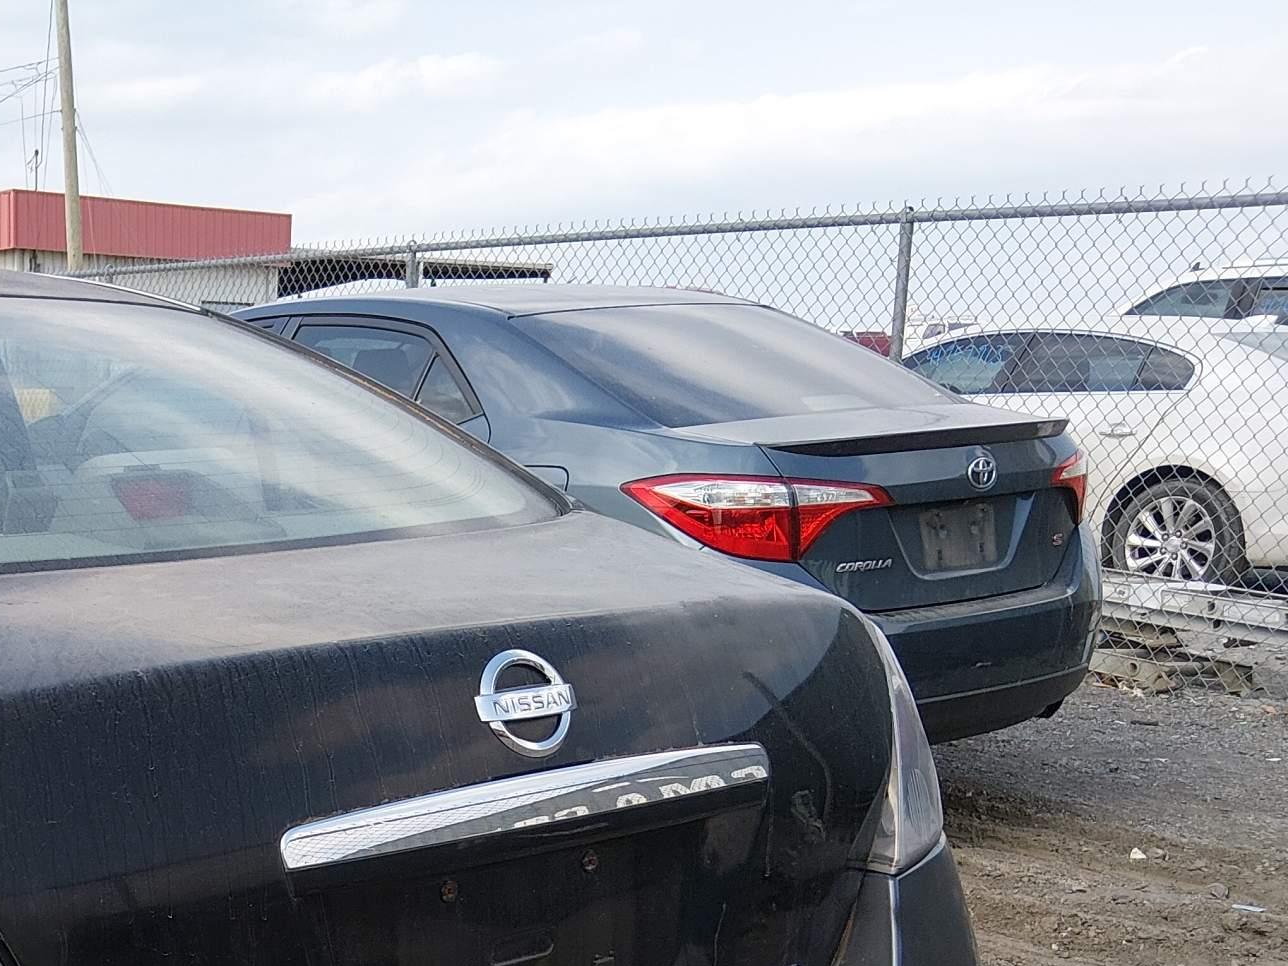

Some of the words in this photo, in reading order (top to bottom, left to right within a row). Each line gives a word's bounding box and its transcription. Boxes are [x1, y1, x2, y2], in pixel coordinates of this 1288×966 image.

[1052, 533, 1064, 547] S
[835, 558, 893, 573] COROLLA
[492, 689, 571, 716] NISSAN
